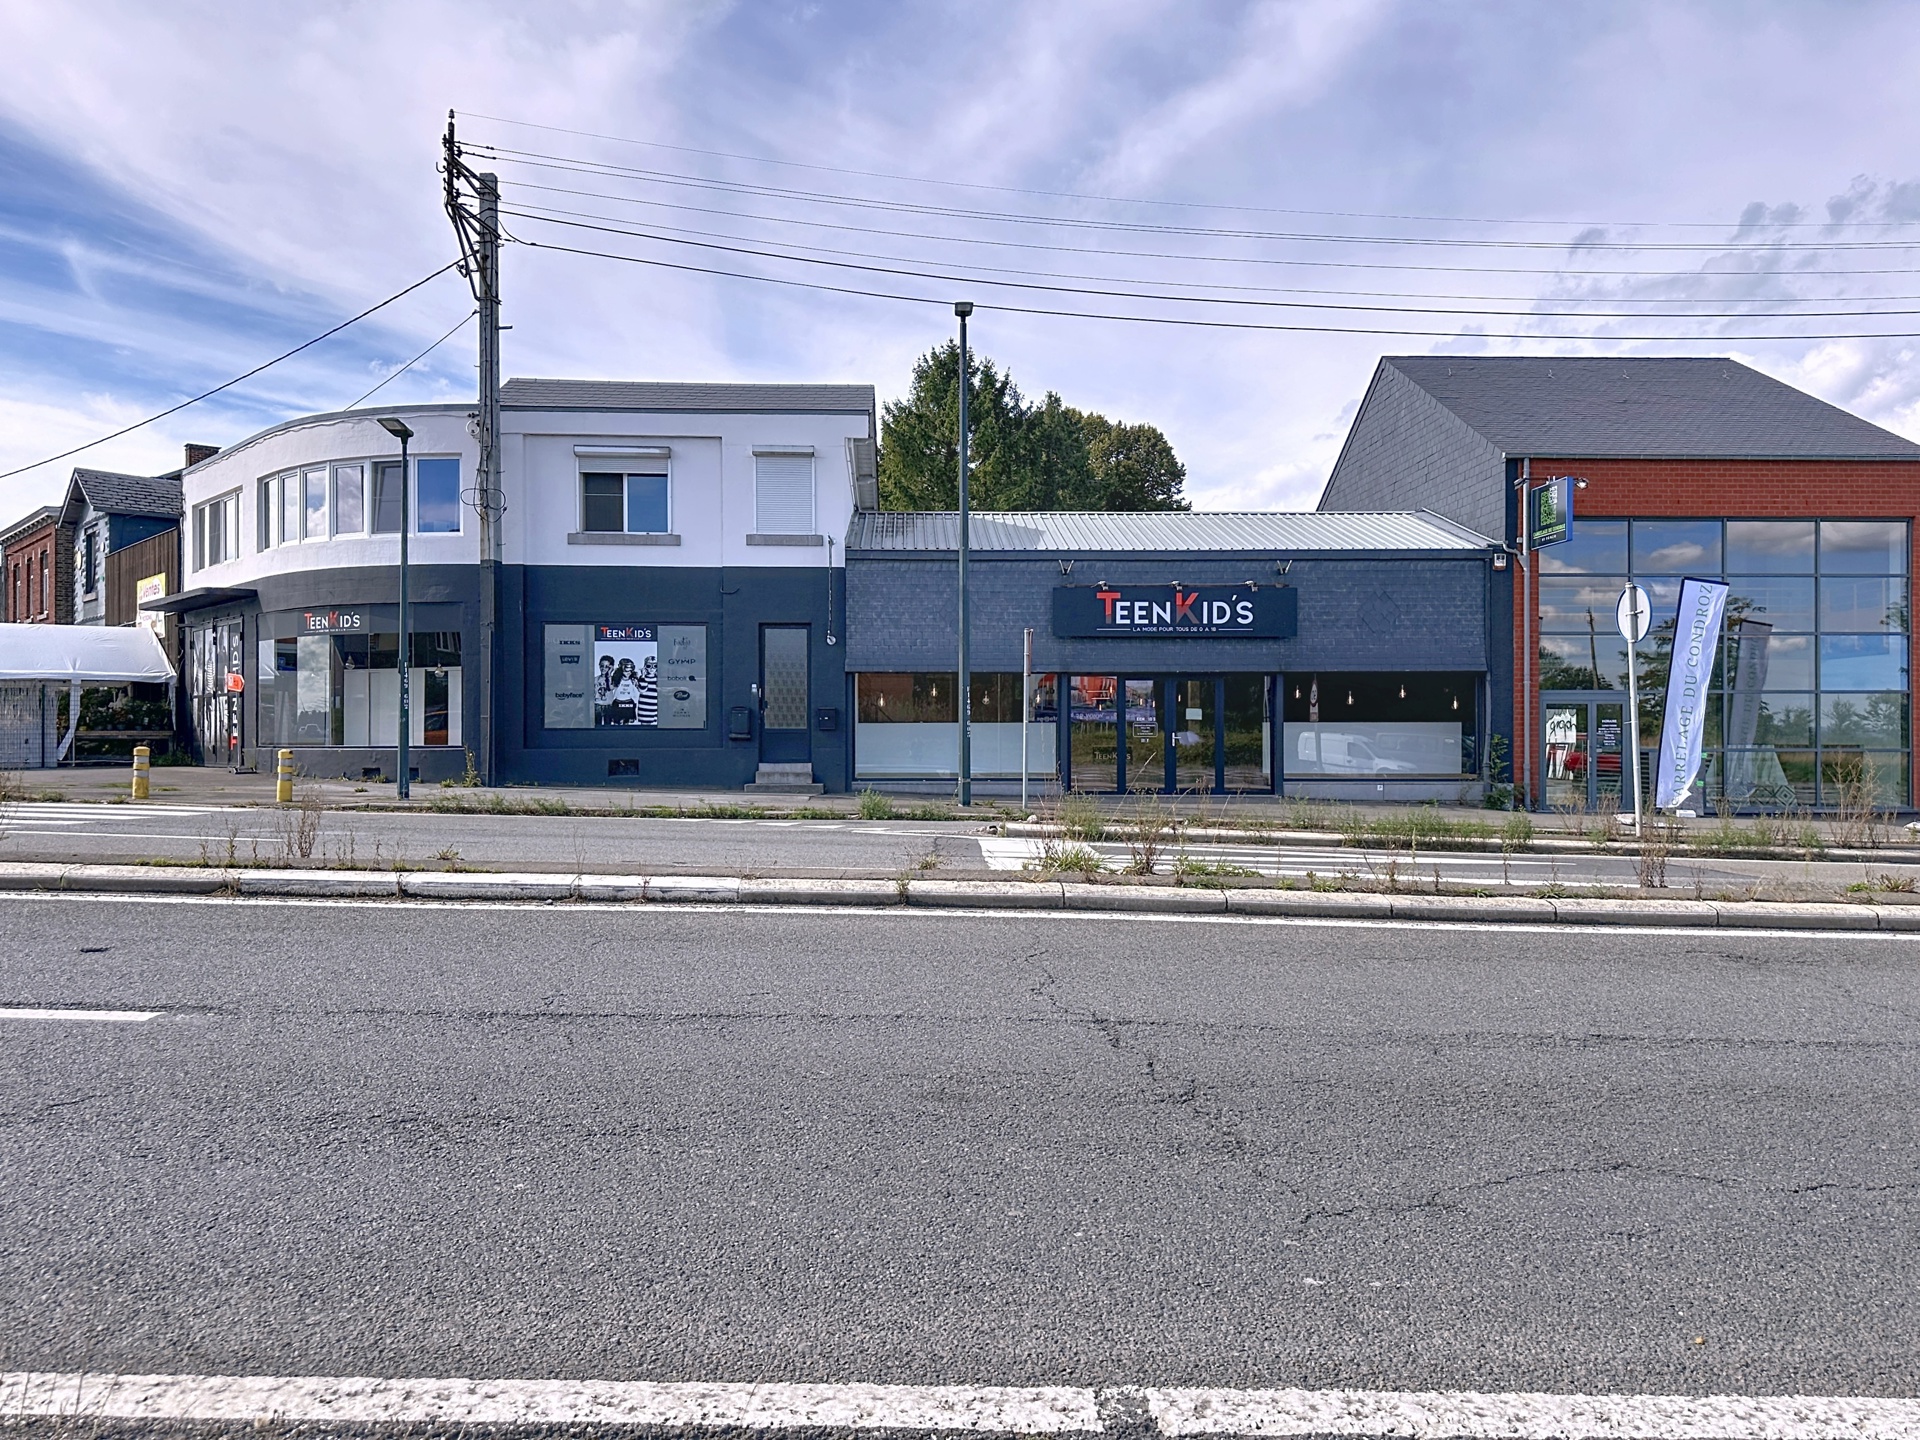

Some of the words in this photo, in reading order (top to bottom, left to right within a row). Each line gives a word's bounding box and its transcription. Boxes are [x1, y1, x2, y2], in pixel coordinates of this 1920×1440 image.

[1096, 592, 1254, 625] TEENKID'S
[303, 610, 361, 630] TEENKID'S
[1687, 584, 1713, 668] CONDROZ
[600, 626, 652, 638] TEENKID'S
[555, 692, 583, 700] babyface
[1683, 674, 1699, 698] DU
[1094, 751, 1131, 760] TEENKS
[1671, 705, 1694, 807] CARRELAGE
